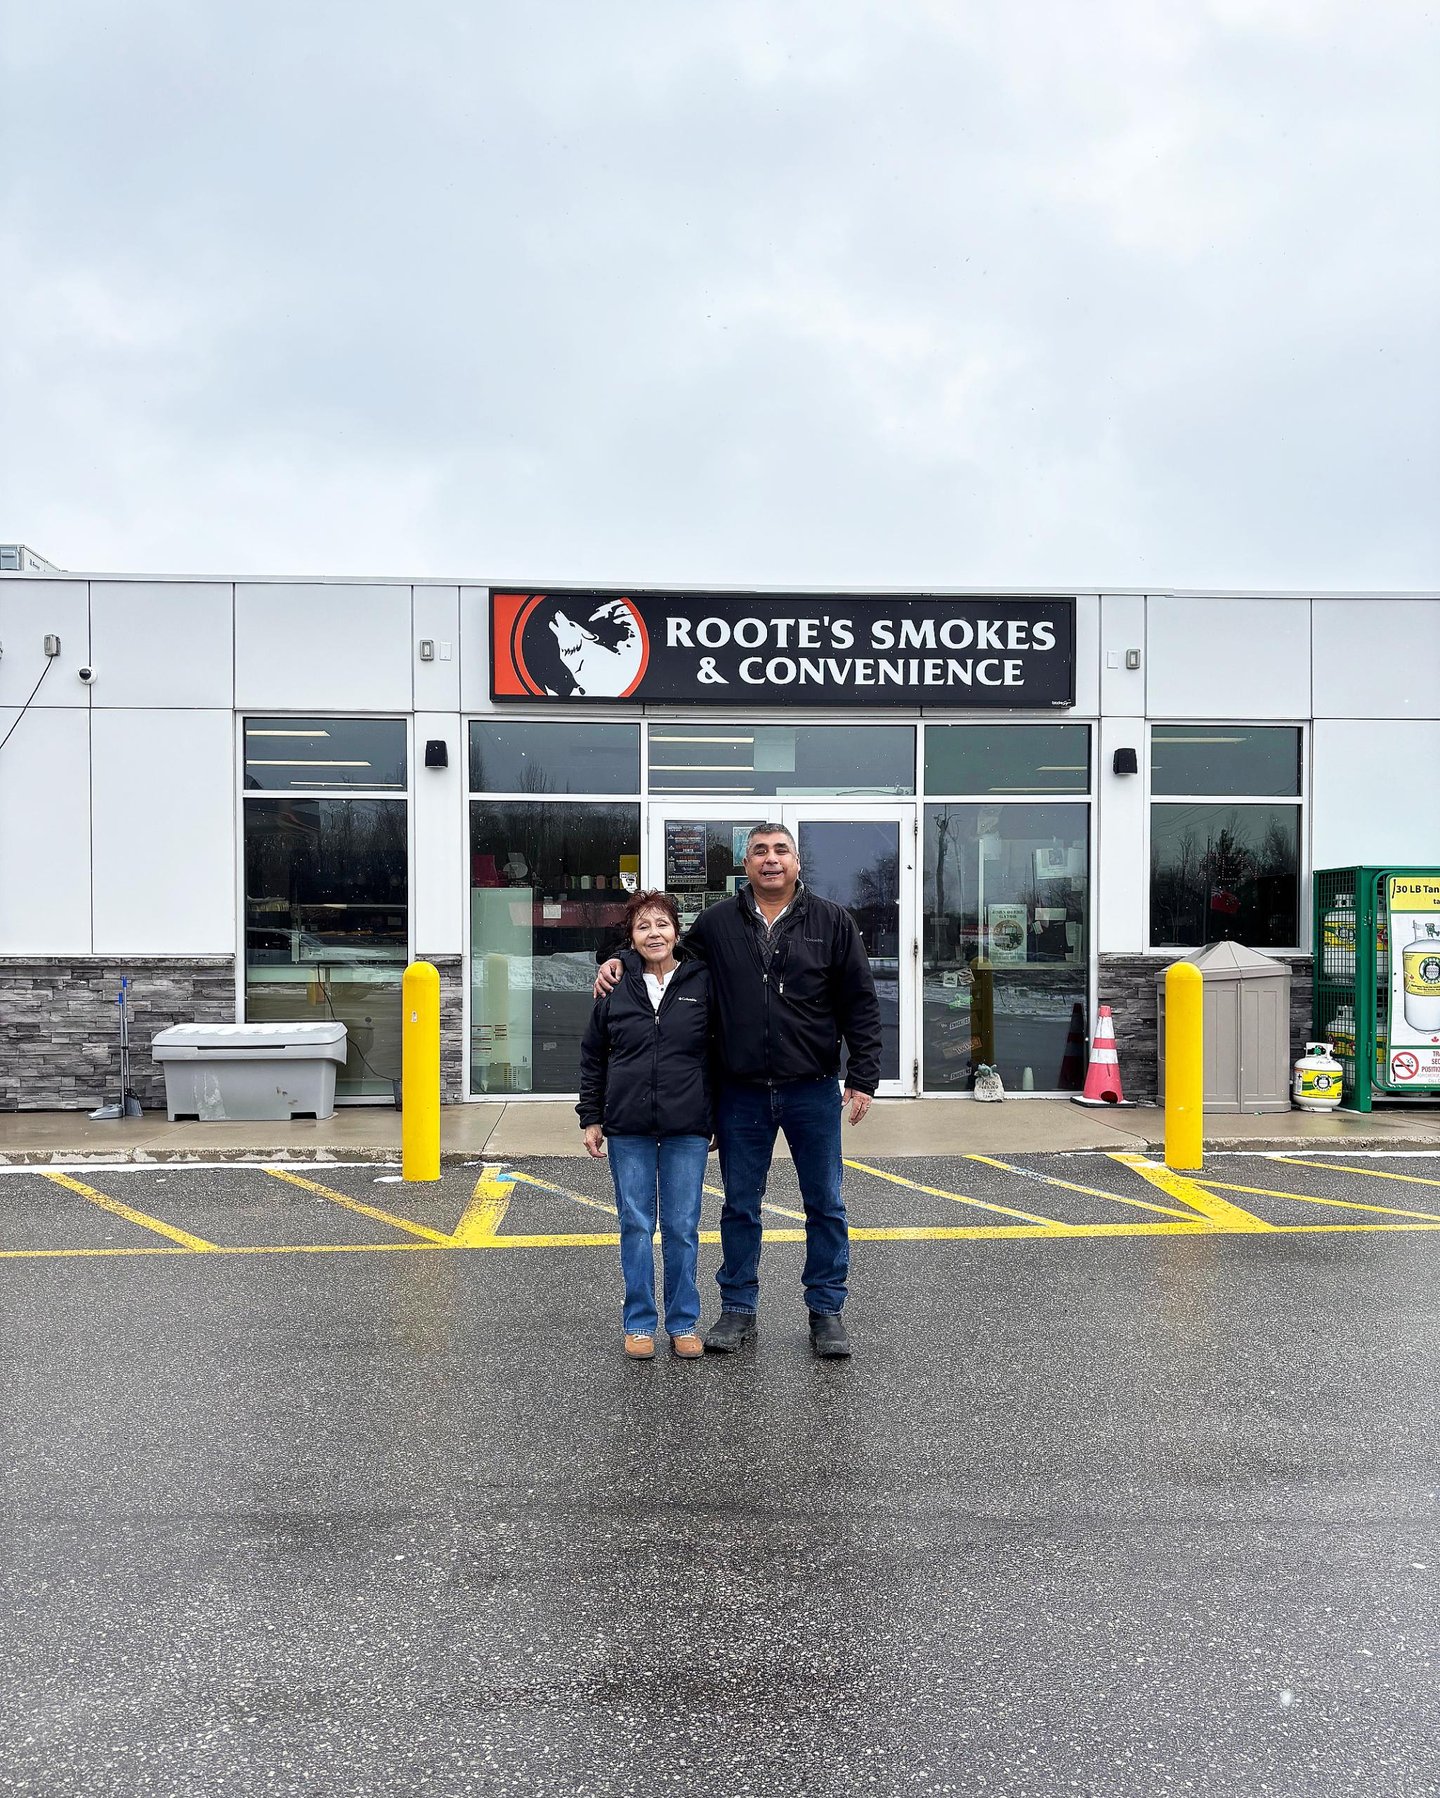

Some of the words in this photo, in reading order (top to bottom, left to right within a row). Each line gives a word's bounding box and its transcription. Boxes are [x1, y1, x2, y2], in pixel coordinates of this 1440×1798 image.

[666, 616, 854, 650] ROOTE'S
[870, 618, 1056, 651] SMOKES
[697, 656, 729, 684] &
[738, 656, 1025, 686] CONVENIENCE
[1396, 885, 1408, 894] 30
[1409, 885, 1422, 894] LB
